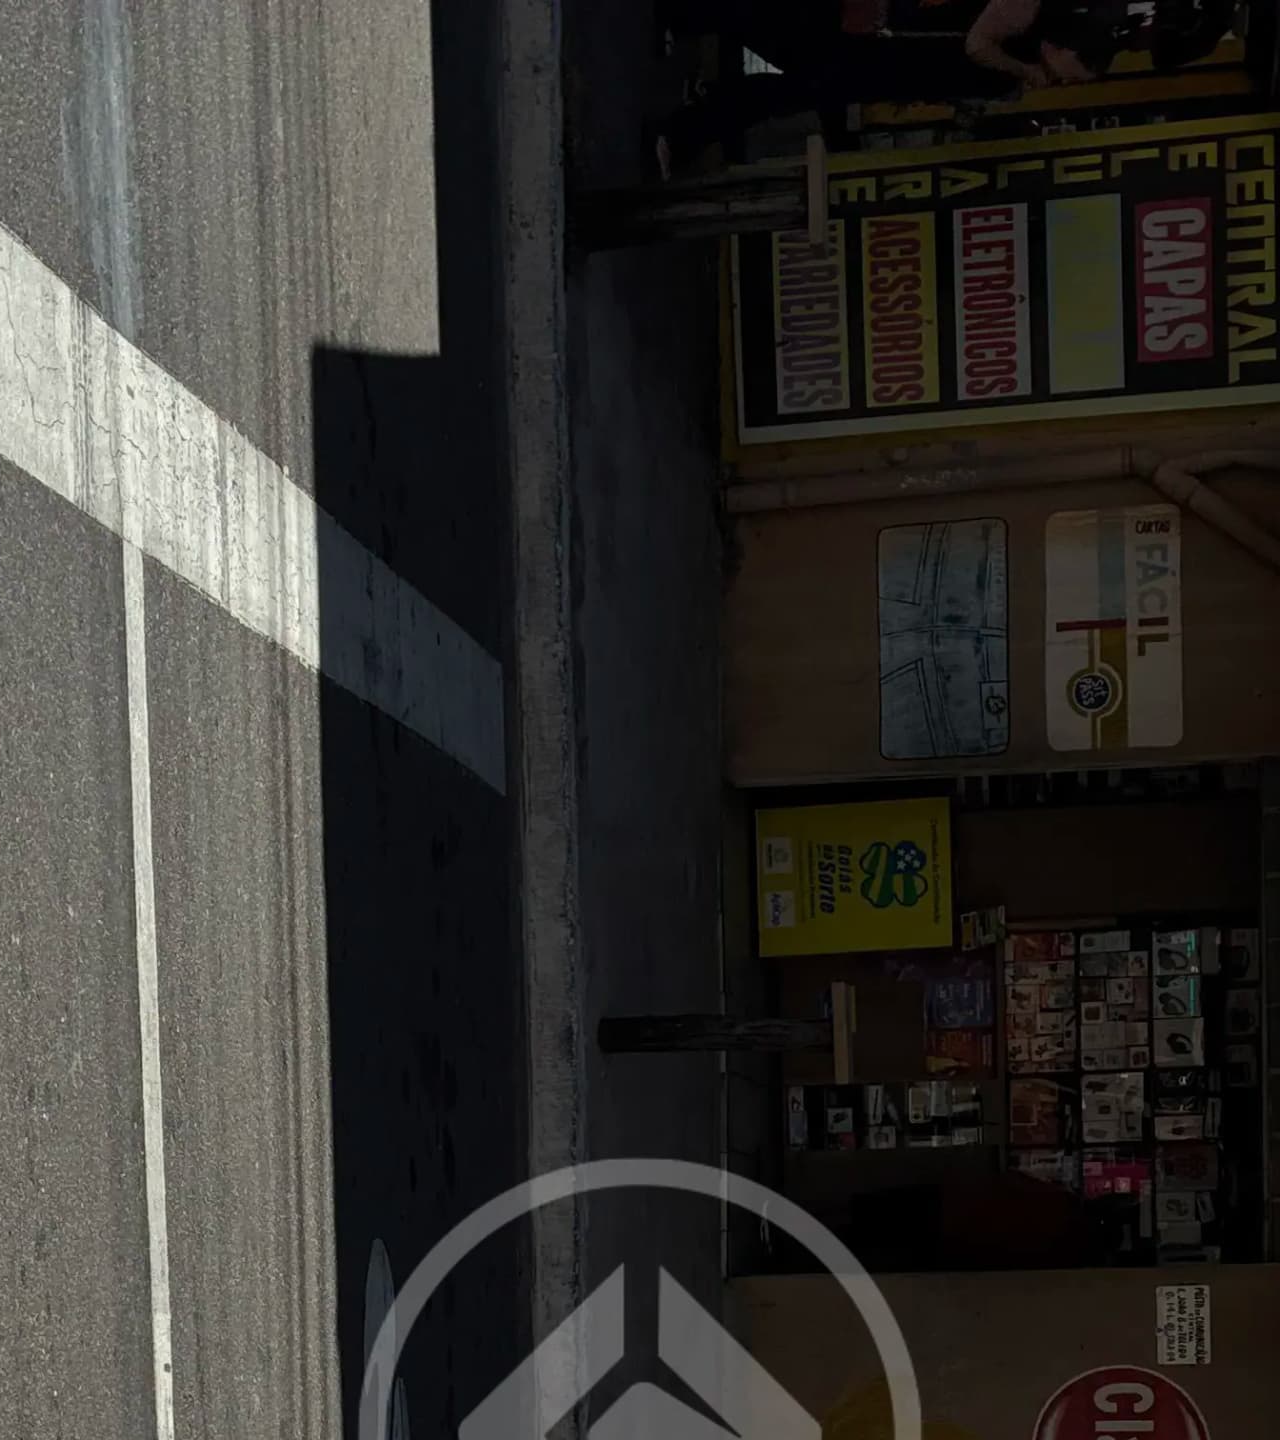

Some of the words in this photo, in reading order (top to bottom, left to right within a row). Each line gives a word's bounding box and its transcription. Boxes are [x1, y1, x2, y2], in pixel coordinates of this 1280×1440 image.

[867, 220, 932, 403] ACESSÓRIOS
[961, 207, 1026, 397] ELETRÔNICOS
[1141, 207, 1208, 353] CAPAS
[1224, 133, 1278, 384] CENTRAL
[1136, 543, 1176, 657] FÁCIL
[1078, 677, 1095, 706] PASS
[817, 861, 836, 914] Sorte
